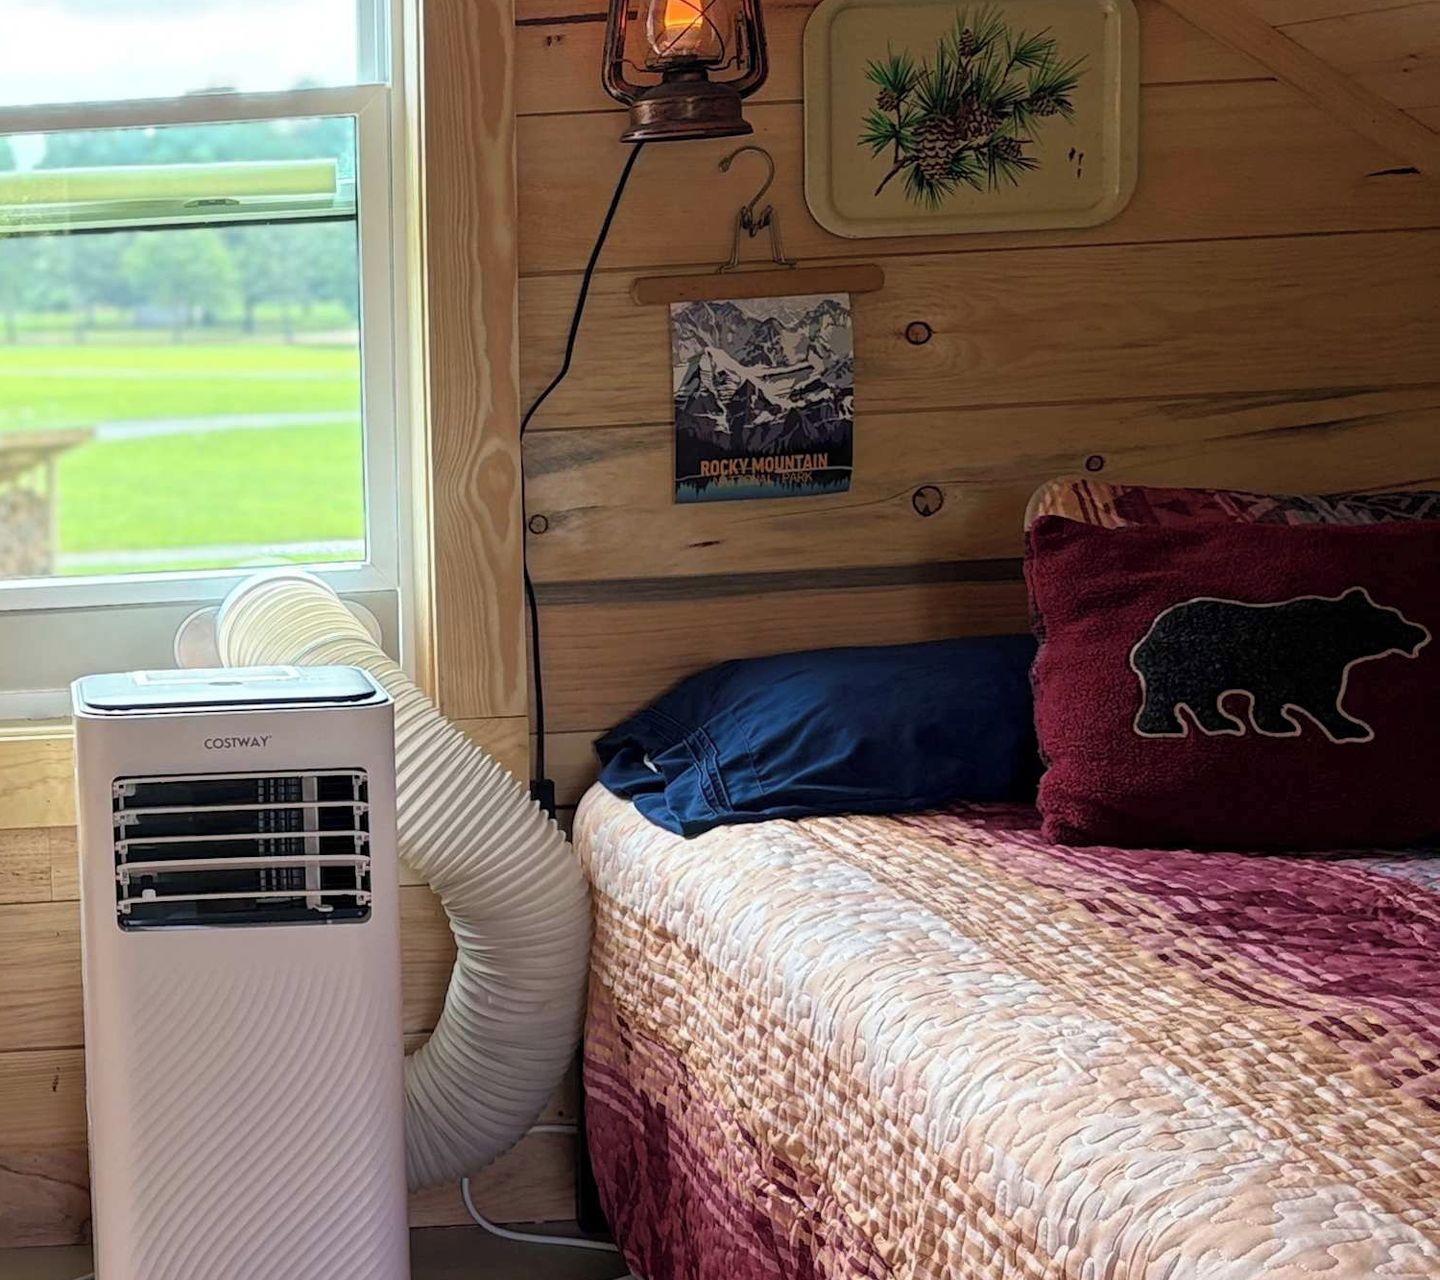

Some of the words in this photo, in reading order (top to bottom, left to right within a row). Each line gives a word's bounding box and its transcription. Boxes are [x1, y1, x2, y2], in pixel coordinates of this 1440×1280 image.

[700, 459, 749, 477] ROCKY
[752, 453, 828, 473] MOUNTAIN
[713, 474, 771, 487] NATIONAL
[781, 470, 813, 484] PARK
[203, 735, 269, 750] COSTWAY
